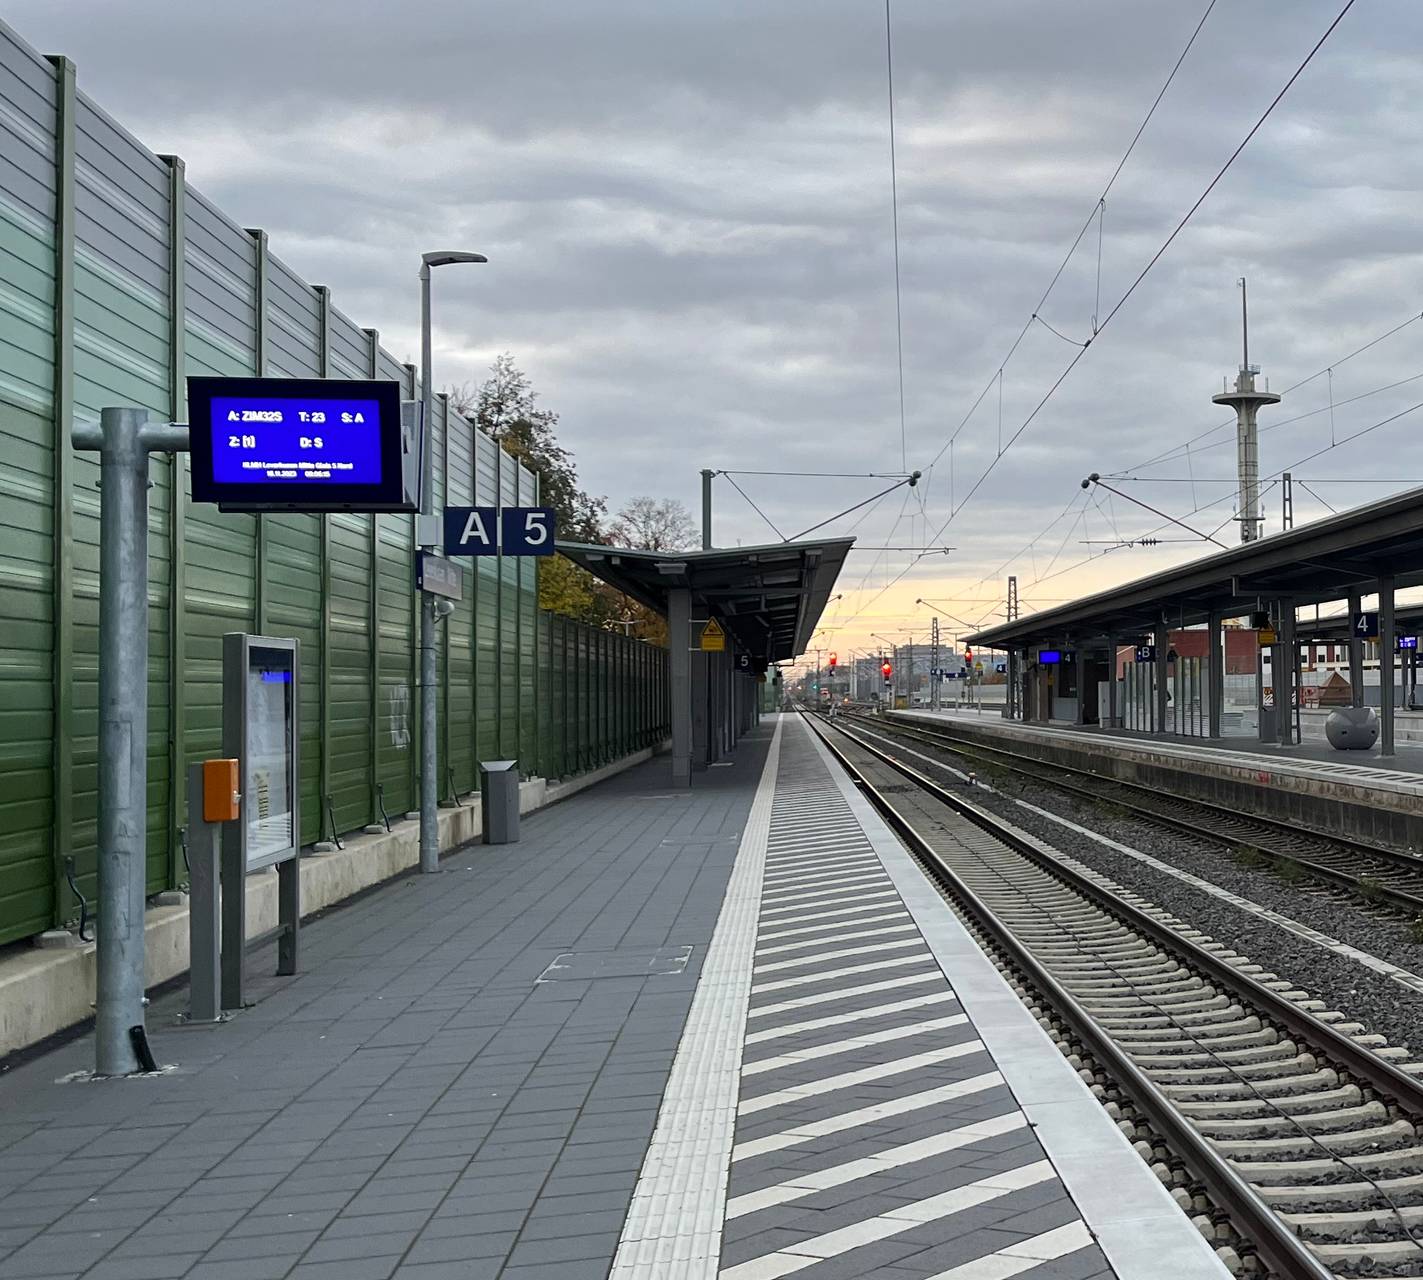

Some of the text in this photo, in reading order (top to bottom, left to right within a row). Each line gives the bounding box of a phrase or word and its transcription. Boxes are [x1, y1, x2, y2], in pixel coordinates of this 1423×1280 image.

[227, 410, 240, 422] A:
[298, 411, 310, 423] T:
[311, 411, 326, 424] 23
[341, 412, 353, 424] S:
[354, 412, 365, 424] A
[299, 436, 312, 449] D:
[313, 437, 324, 449] S
[459, 511, 548, 545] A 5
[1357, 615, 1369, 632] 4
[1064, 653, 1071, 663] 4
[1141, 646, 1150, 658] B
[740, 655, 749, 667] 5
